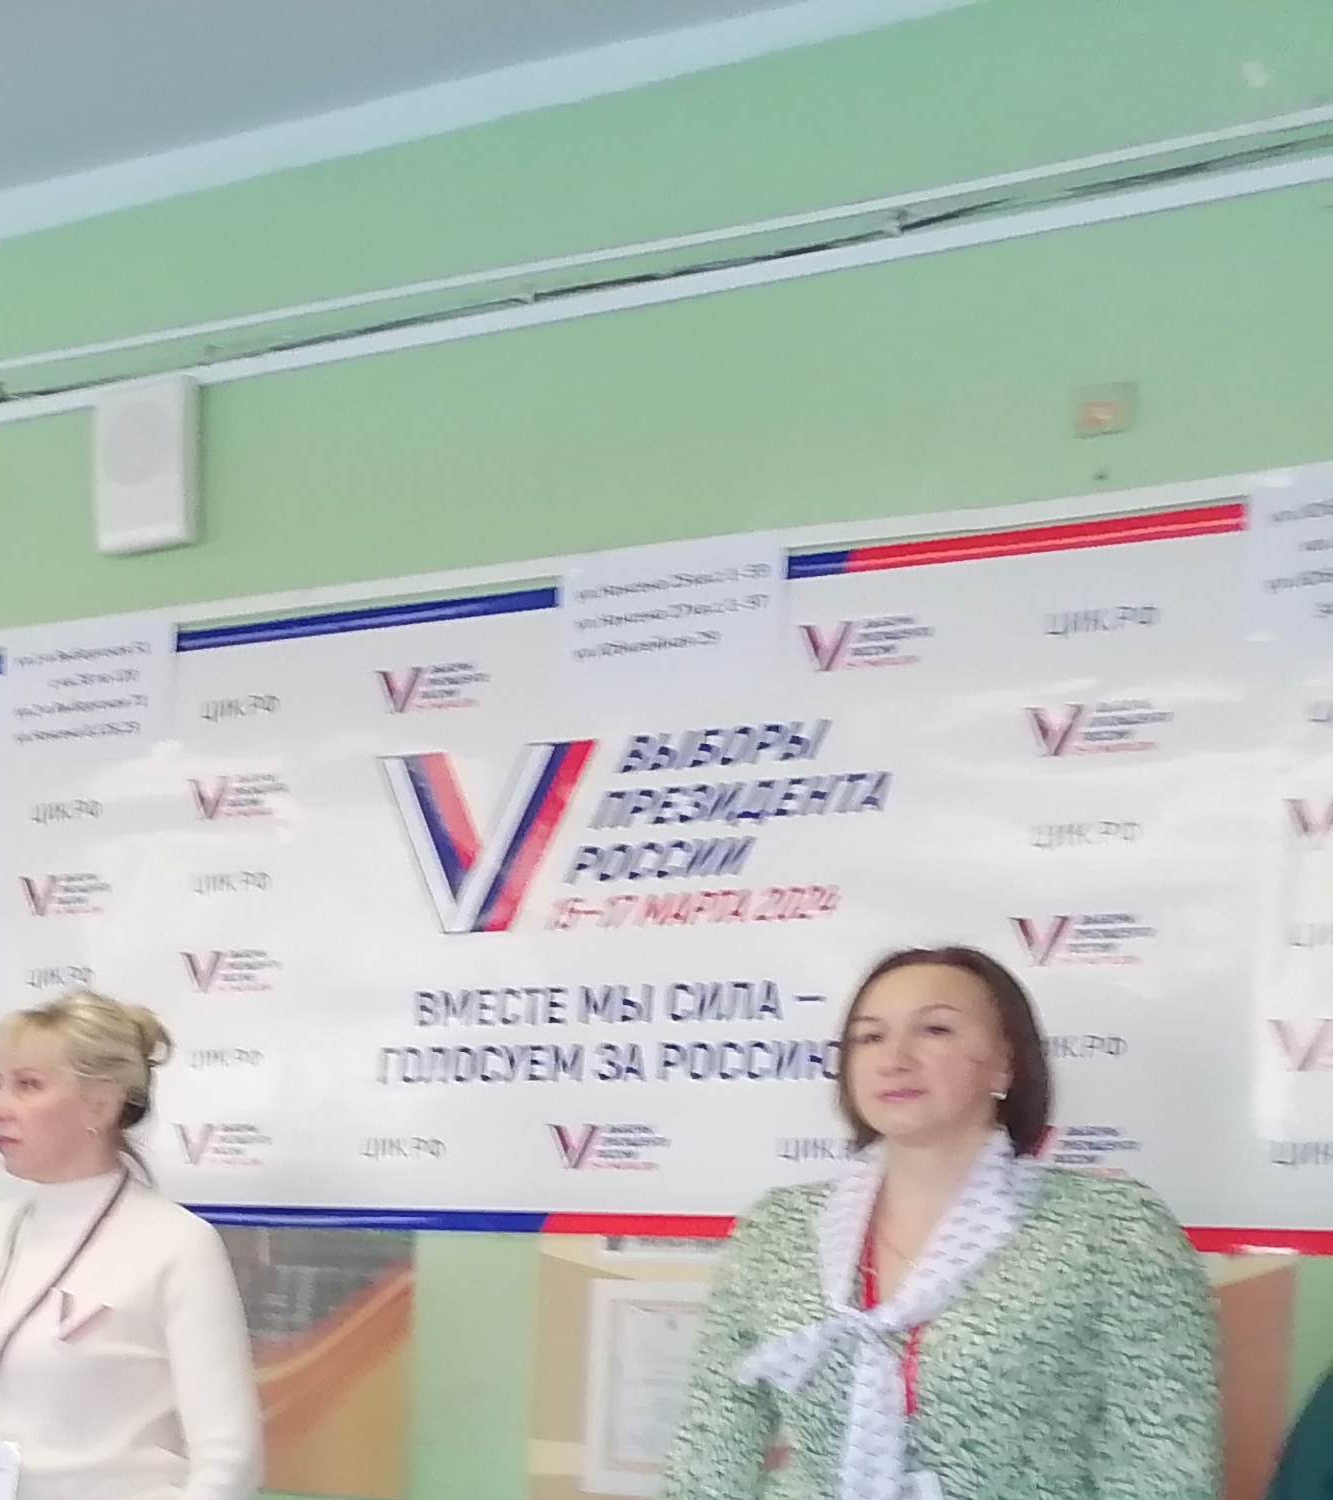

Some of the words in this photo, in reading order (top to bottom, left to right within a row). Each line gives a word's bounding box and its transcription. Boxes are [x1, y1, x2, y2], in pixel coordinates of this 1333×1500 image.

[615, 718, 833, 774] ВЫБОРЫ
[587, 769, 895, 831] ПРЕЗИДЕНТА
[562, 835, 759, 884] РОССИИ
[640, 887, 753, 929] МАРТА
[753, 883, 844, 924] 2024
[413, 986, 570, 1028] ВМЕСТЕ
[576, 982, 657, 1025] МЫ
[665, 979, 785, 1023] СИЛА
[375, 1041, 586, 1085] ГОЛОСУЕМ
[592, 1041, 647, 1083] ЗА
[1043, 1033, 1129, 1062] ИК.РФ
